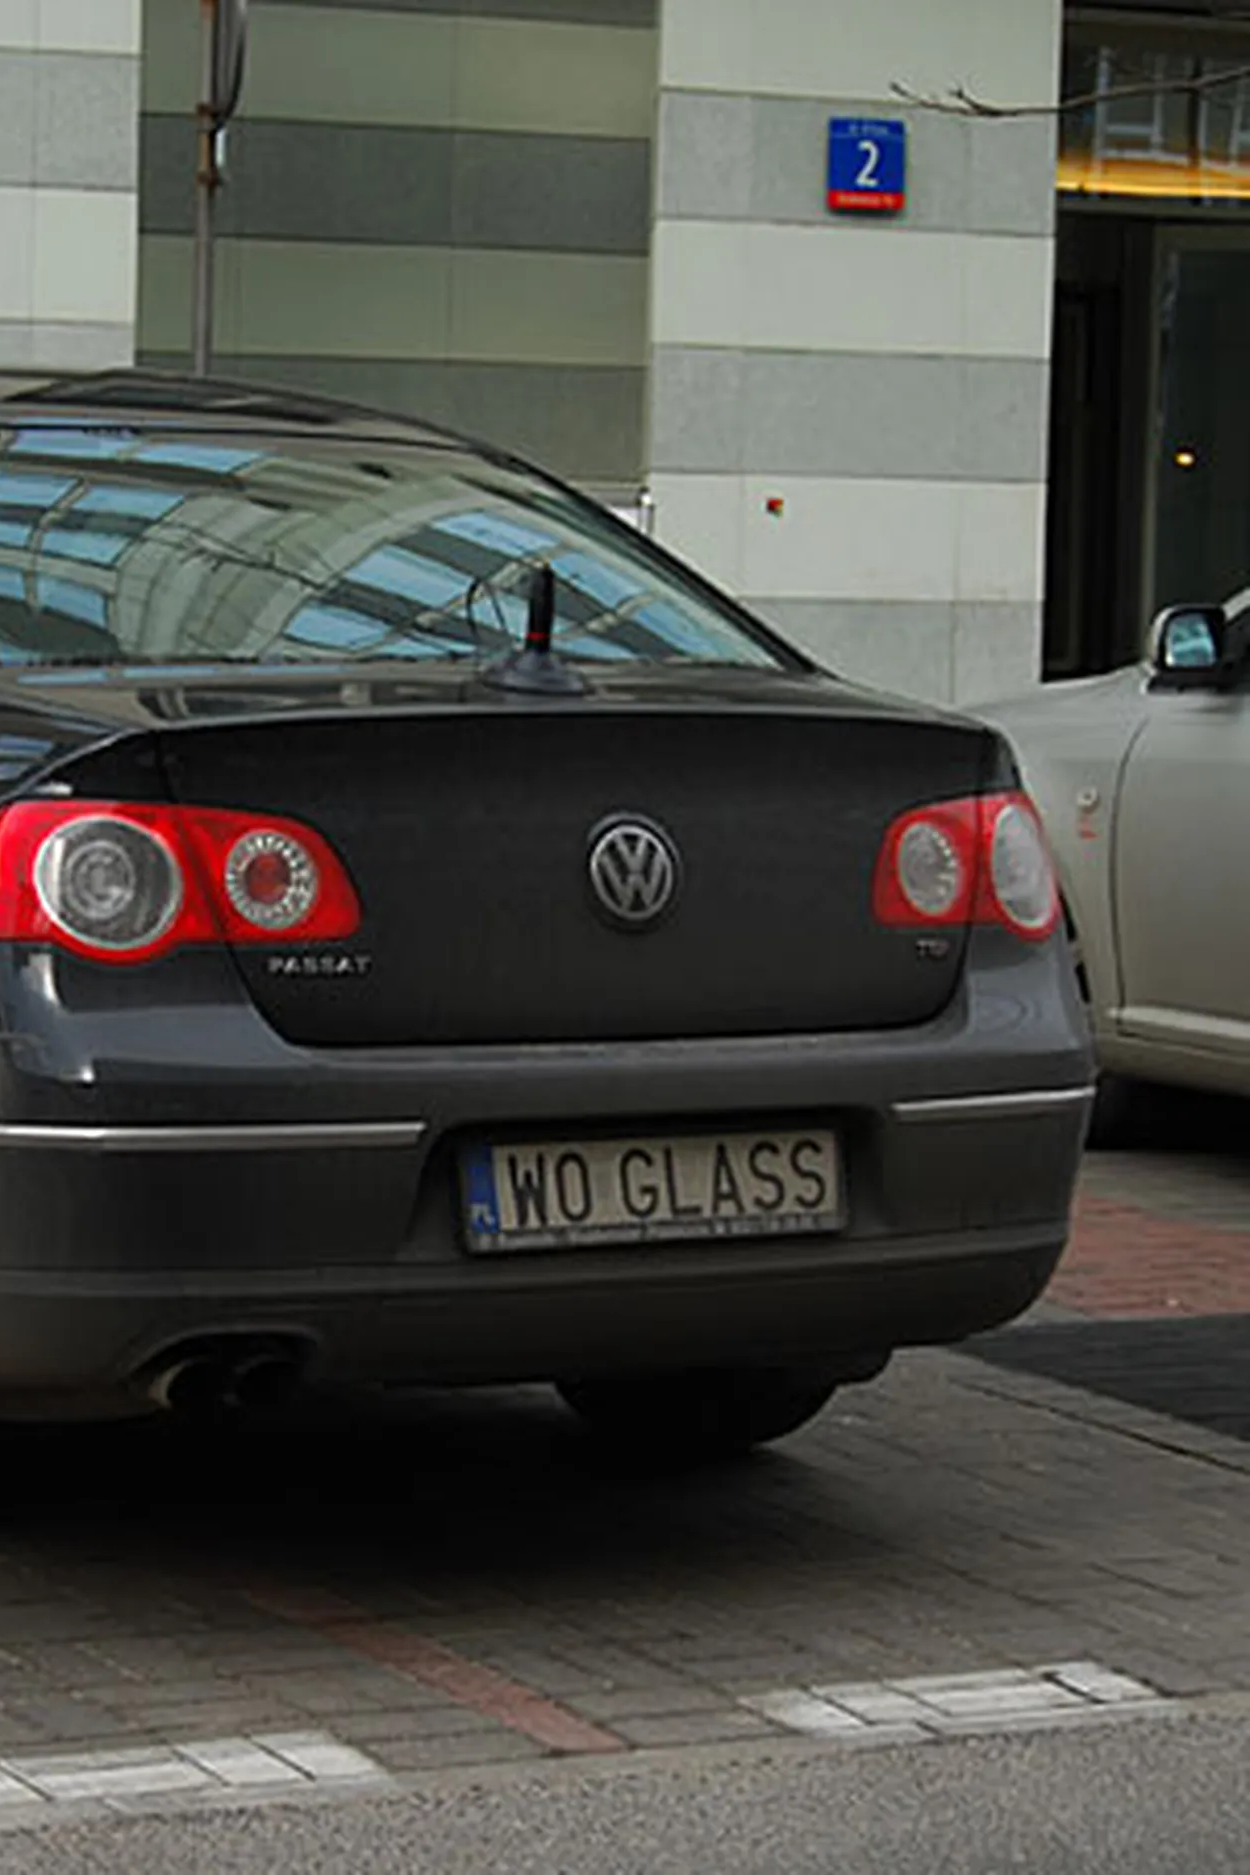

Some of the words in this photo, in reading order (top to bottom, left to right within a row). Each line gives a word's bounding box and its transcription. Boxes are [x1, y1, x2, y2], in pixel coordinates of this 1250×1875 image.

[855, 140, 879, 187] 2
[268, 956, 371, 974] PASSAT
[508, 1150, 593, 1228] WO
[619, 1138, 827, 1220] GLASS
